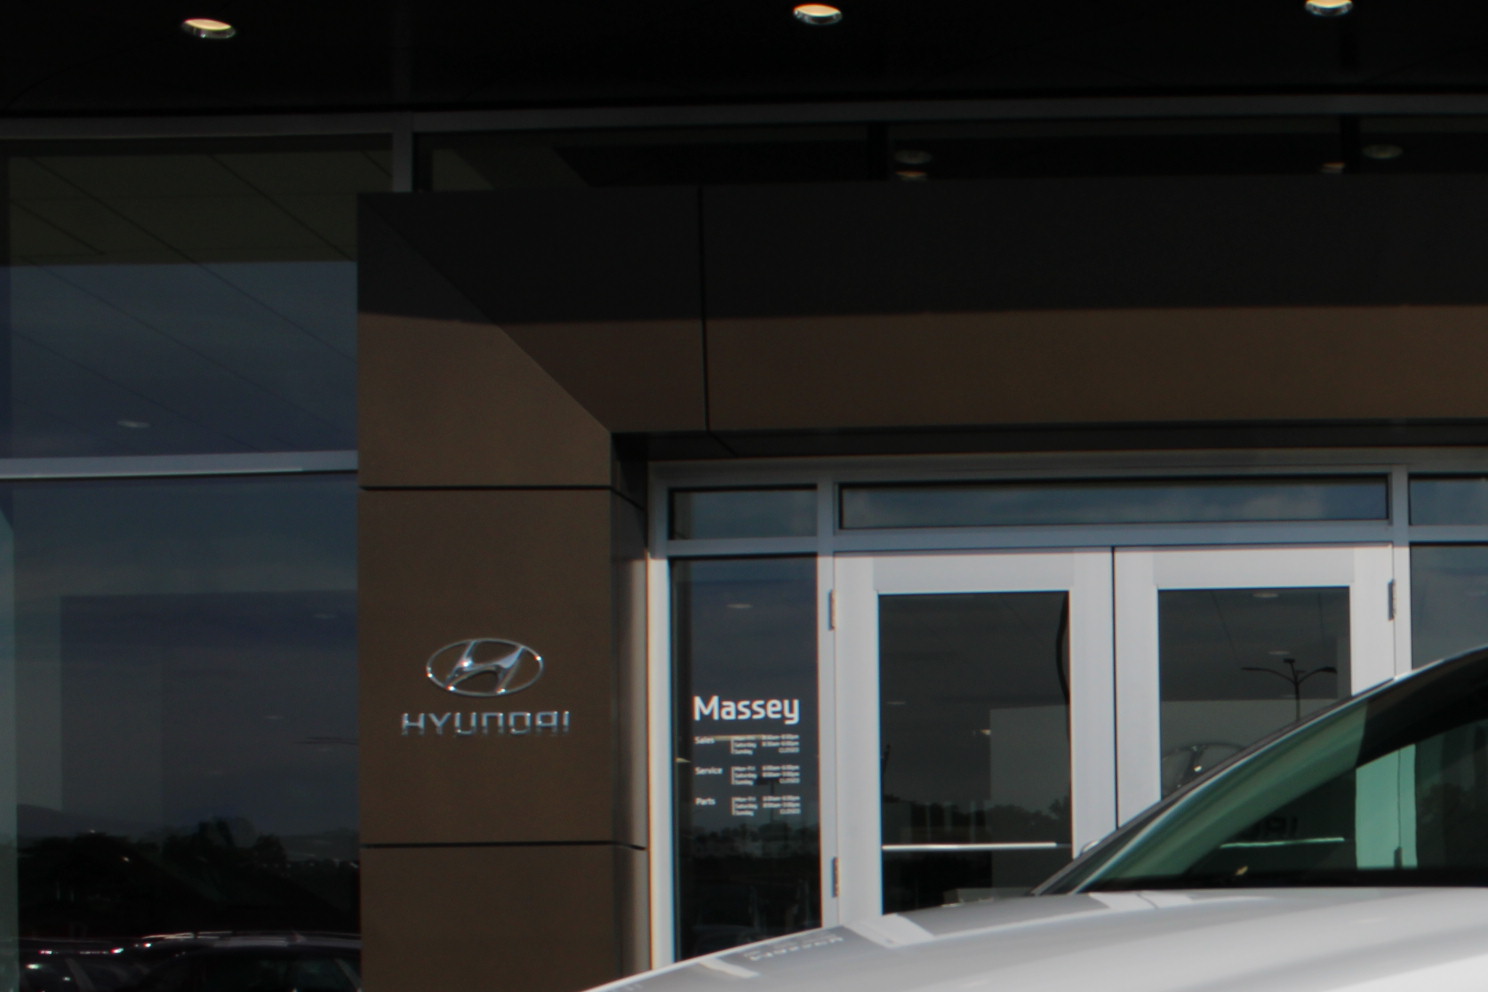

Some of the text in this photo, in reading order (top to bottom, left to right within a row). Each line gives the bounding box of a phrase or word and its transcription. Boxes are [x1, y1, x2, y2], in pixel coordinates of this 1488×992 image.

[693, 695, 800, 725] Massey
[401, 710, 571, 736] HYUNDAI
[694, 735, 716, 745] Sales
[694, 765, 723, 775] Service
